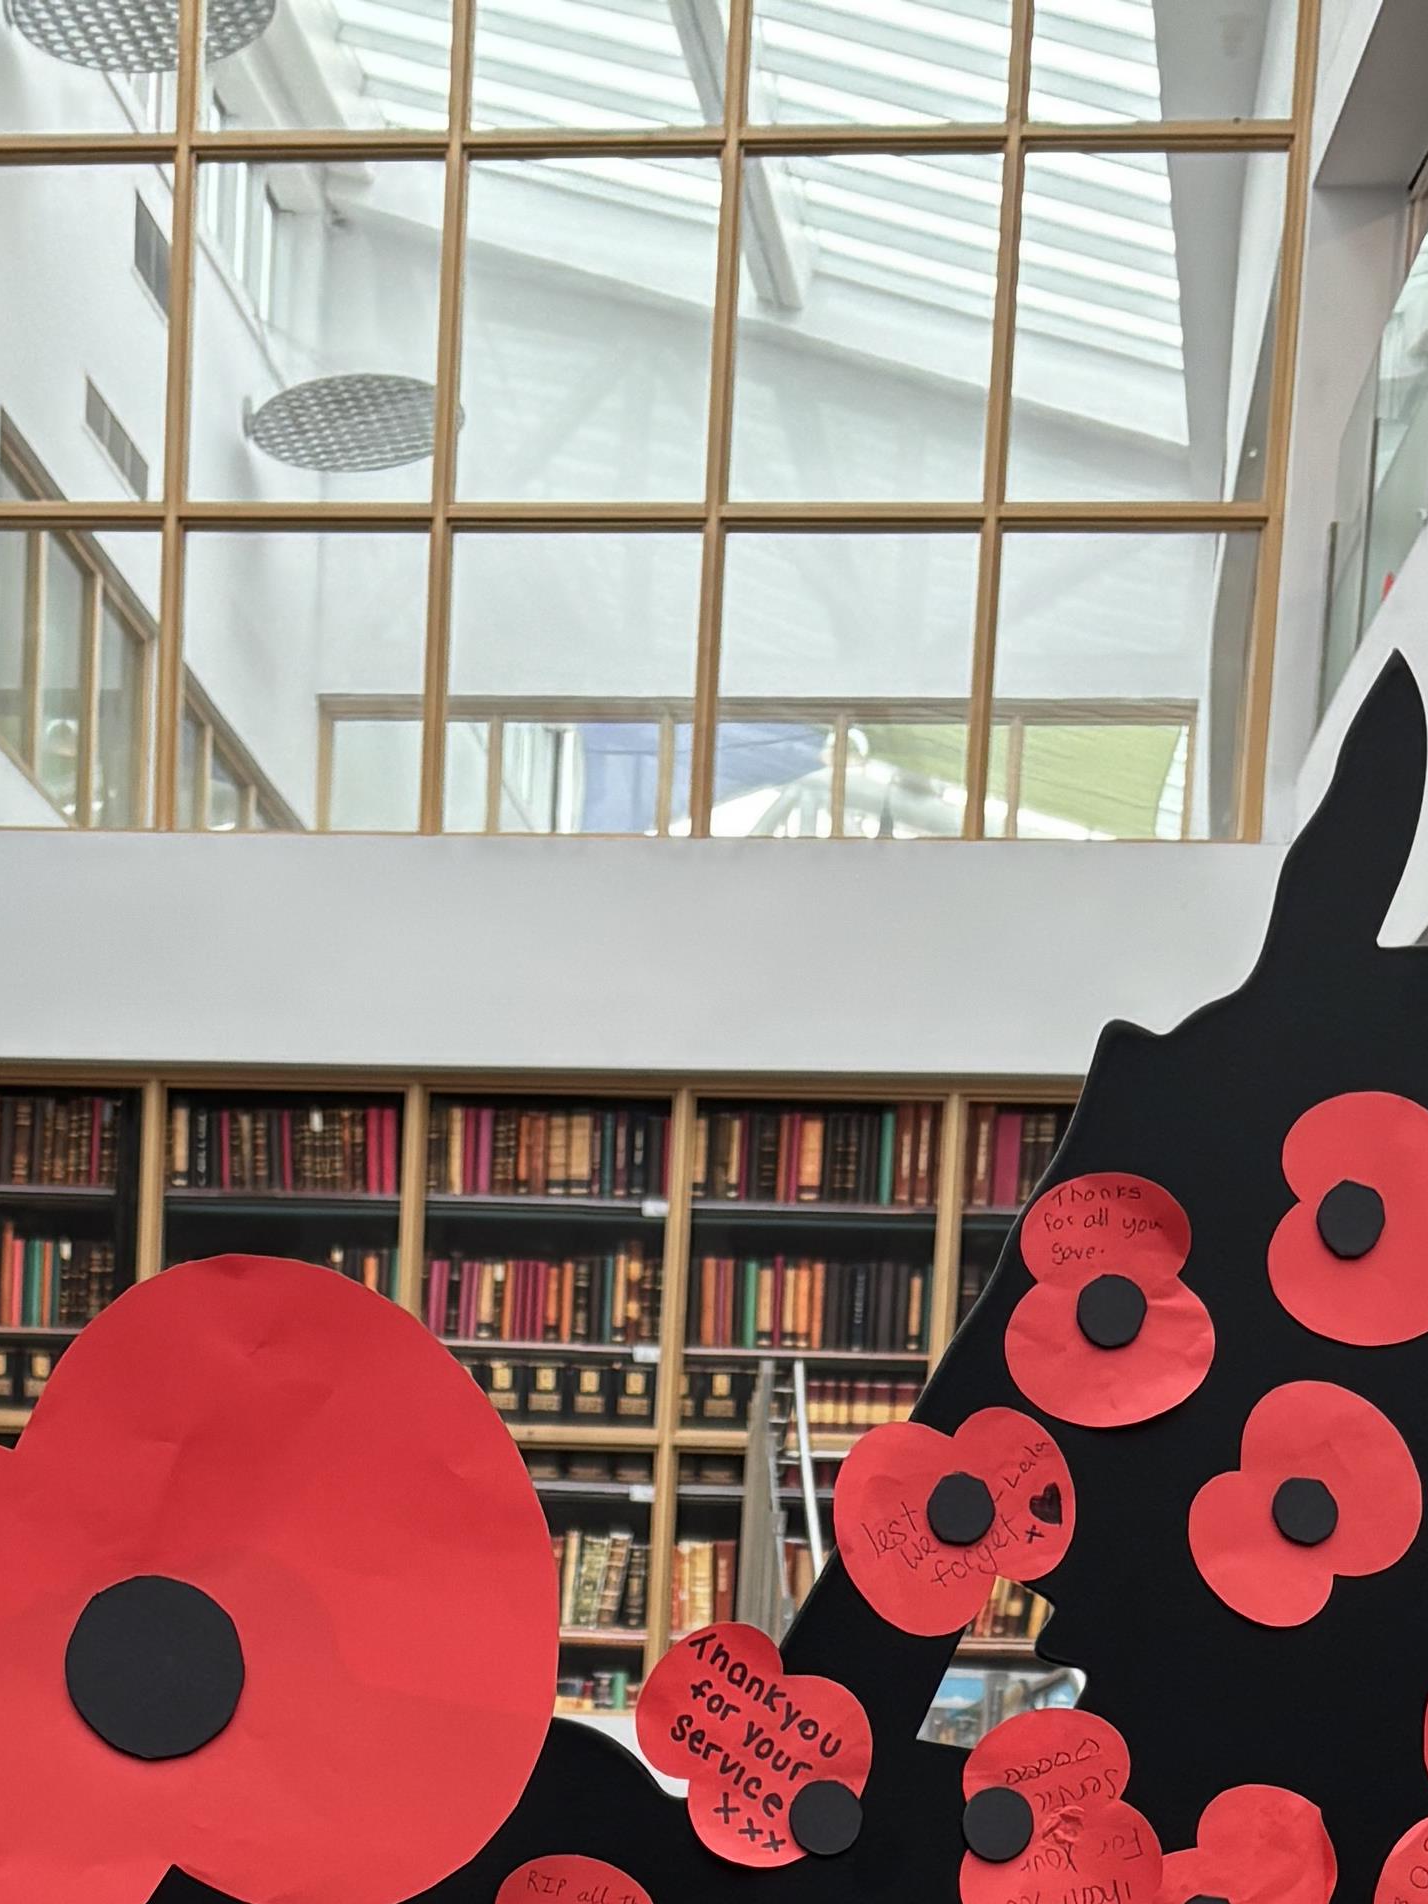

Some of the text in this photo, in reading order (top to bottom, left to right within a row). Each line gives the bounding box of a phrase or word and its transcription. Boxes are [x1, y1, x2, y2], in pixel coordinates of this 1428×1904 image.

[1083, 1207, 1109, 1229] all
[1122, 1216, 1164, 1239] you
[690, 1679, 814, 1782] for your
[526, 1870, 567, 1897] RIP
